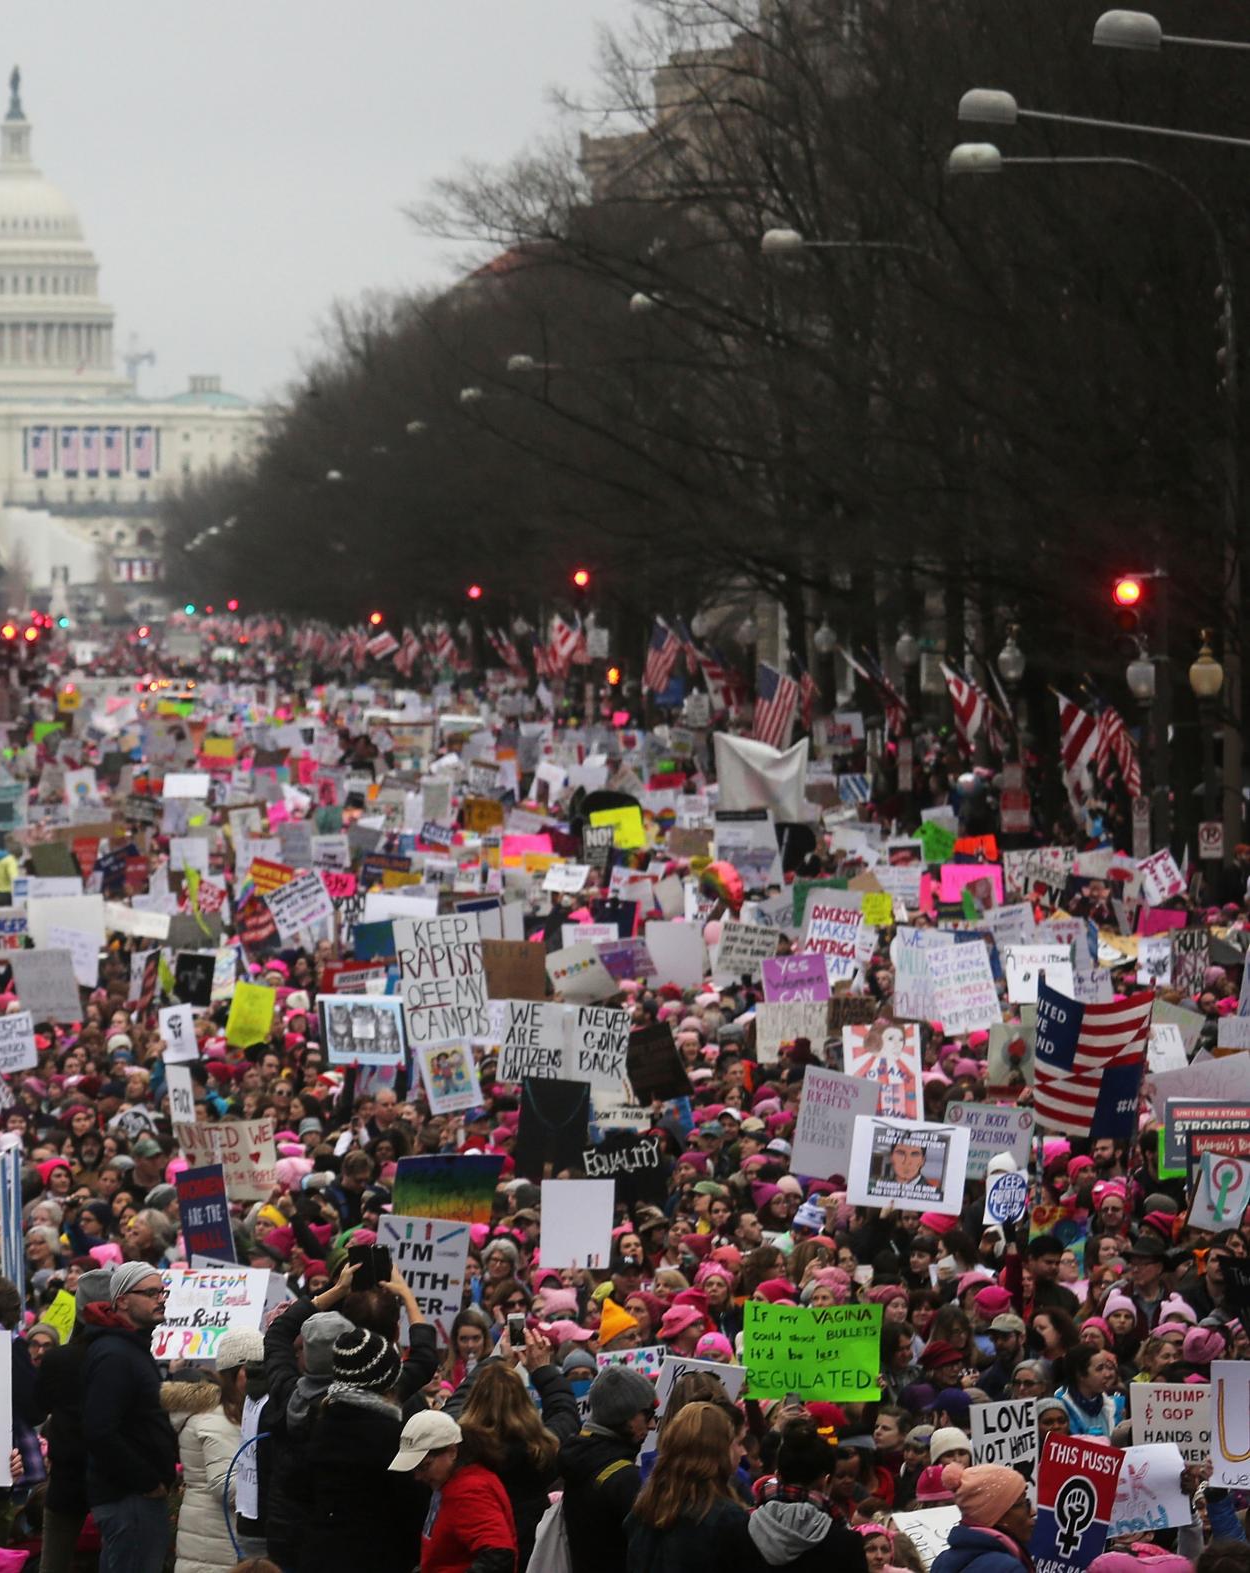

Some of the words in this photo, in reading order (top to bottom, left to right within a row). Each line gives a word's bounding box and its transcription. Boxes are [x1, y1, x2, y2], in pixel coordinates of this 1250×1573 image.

[812, 905, 863, 926] DIVERSITY
[413, 919, 467, 947] KEEP
[811, 921, 857, 940] MAKES
[805, 937, 855, 958] AMERICA
[398, 942, 484, 979] RAPISTS
[775, 959, 808, 976] Yes
[408, 981, 451, 1009] OFF
[455, 977, 484, 1010] MY
[780, 989, 814, 1002] CAN
[410, 1006, 489, 1040] CAMPUS
[510, 1002, 543, 1027] WE
[578, 1007, 630, 1032] NEVER
[505, 1026, 540, 1046] ARE
[504, 1047, 562, 1068] CITIZENS
[579, 1050, 623, 1079] BACK
[808, 1074, 860, 1099] WOMEN'S
[806, 1090, 851, 1110] RIGHTS
[965, 1111, 980, 1127] MY
[983, 1113, 1010, 1128] BODY
[248, 1124, 272, 1145] WE
[583, 1137, 659, 1176] EQUALITY
[998, 1174, 1022, 1191] KEEP
[398, 1242, 433, 1262] I'M
[403, 1270, 449, 1291] ITH
[415, 1297, 443, 1316] ER
[811, 1308, 872, 1325] VAGINA
[190, 1307, 231, 1328] Right
[826, 1326, 877, 1341] BULLETS
[745, 1368, 871, 1389] REGULATED
[1153, 1389, 1204, 1402] TRUMP
[983, 1401, 1034, 1434] LOVE
[1162, 1408, 1194, 1420] GOP
[1144, 1430, 1192, 1443] HANDS
[974, 1439, 1005, 1466] NOT
[1010, 1431, 1036, 1459] HATE
[1050, 1442, 1078, 1464] THIS
[1081, 1450, 1119, 1476] PUSSY
